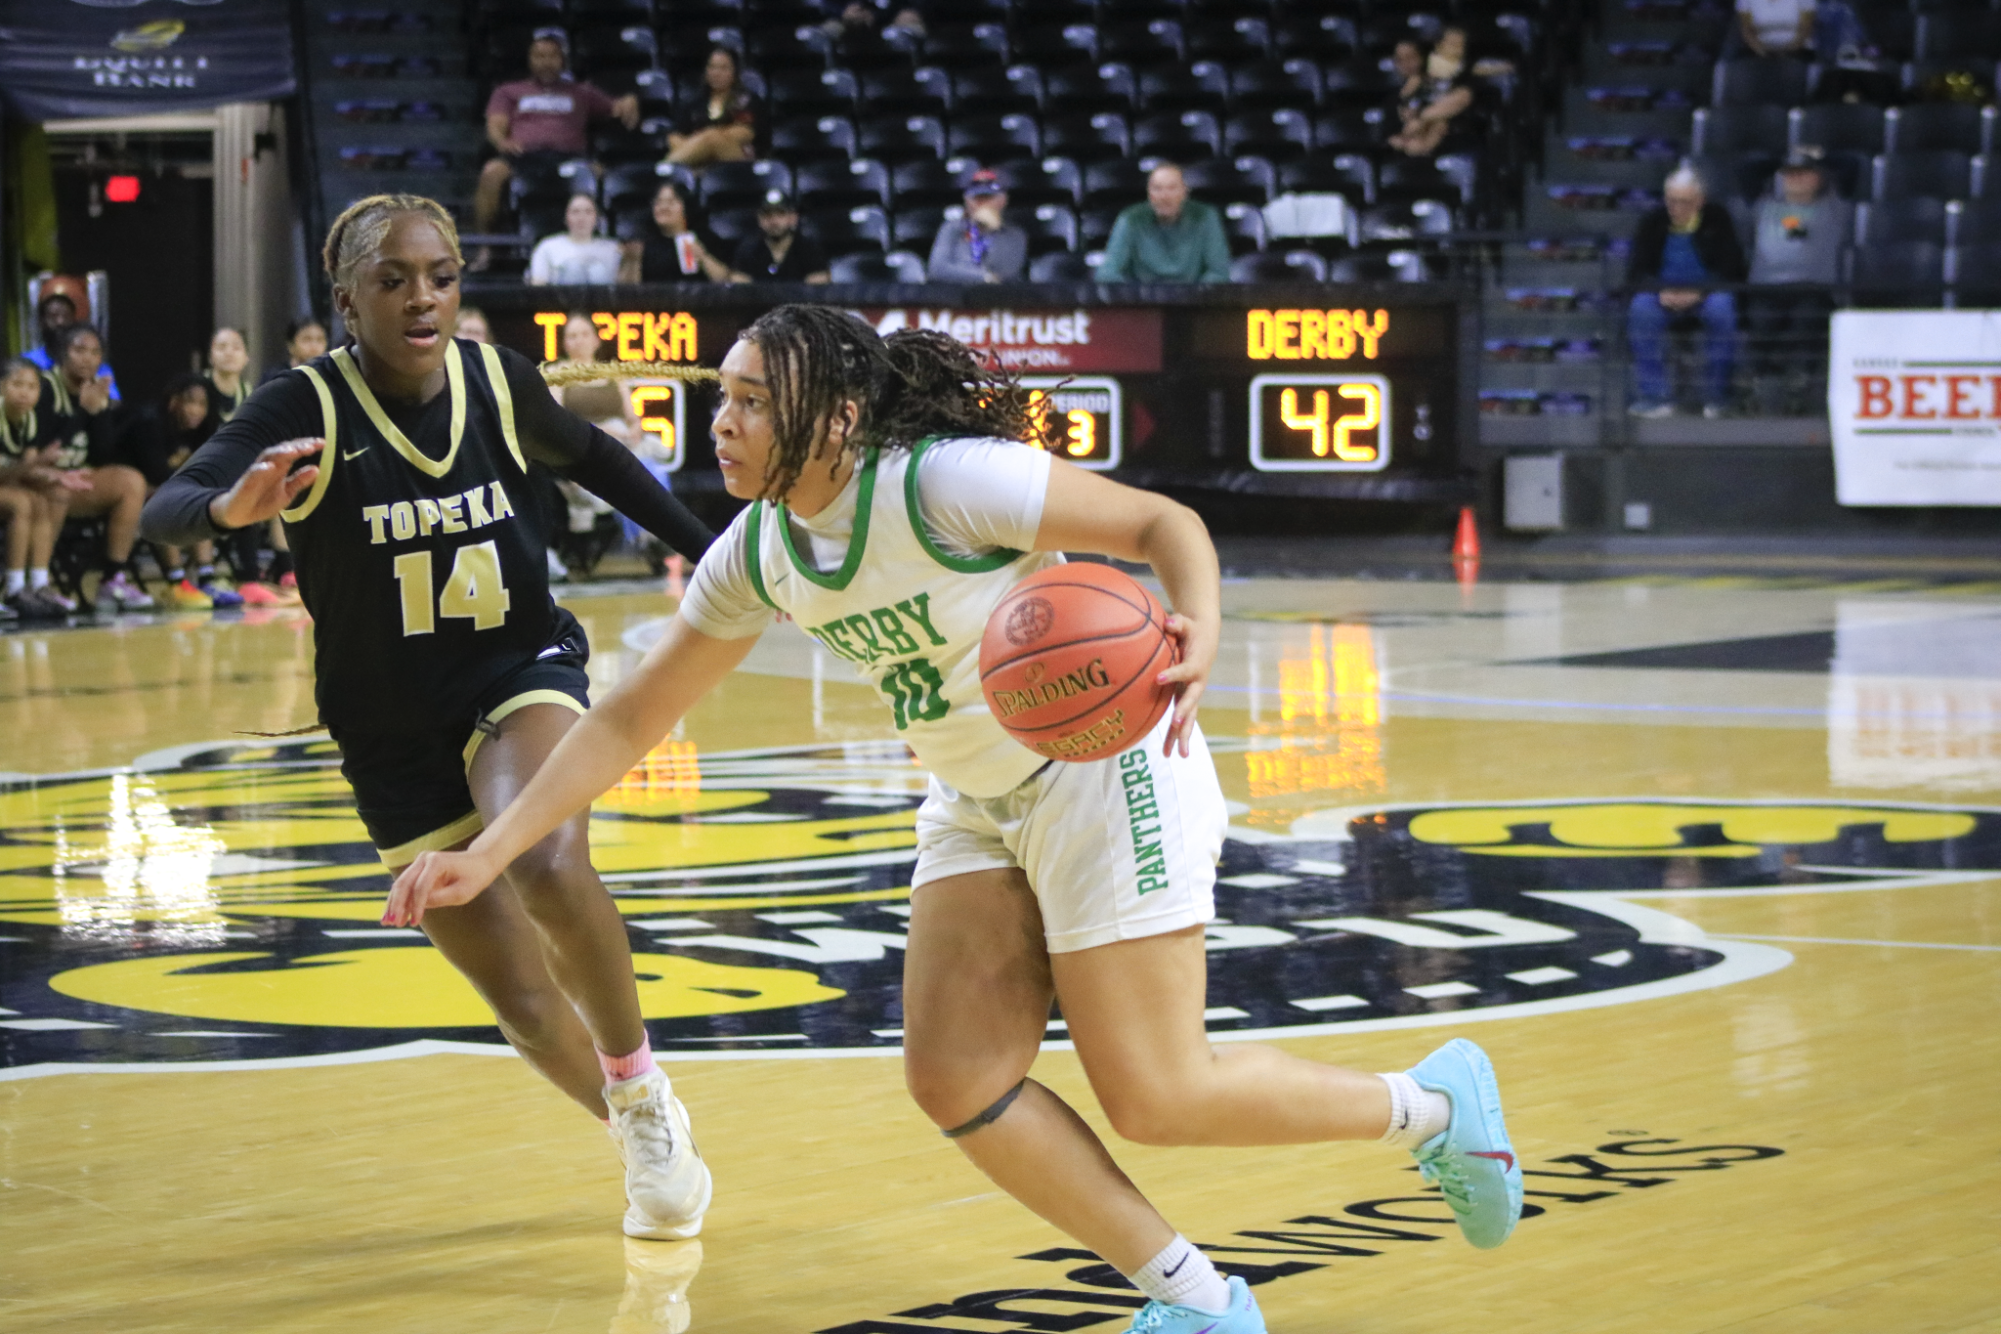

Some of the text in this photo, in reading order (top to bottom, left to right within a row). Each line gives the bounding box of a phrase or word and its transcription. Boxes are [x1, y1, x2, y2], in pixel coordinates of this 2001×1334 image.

[534, 312, 698, 361] TPEKA
[919, 309, 1090, 345] Meritrust
[1247, 309, 1389, 360] DERBY
[1067, 408, 1097, 457] 3
[1280, 383, 1382, 462] 42
[362, 480, 515, 544] TOPEKA
[393, 539, 510, 637] 14
[992, 658, 1112, 717] SPALDING
[1119, 748, 1169, 896] PANTHERS
